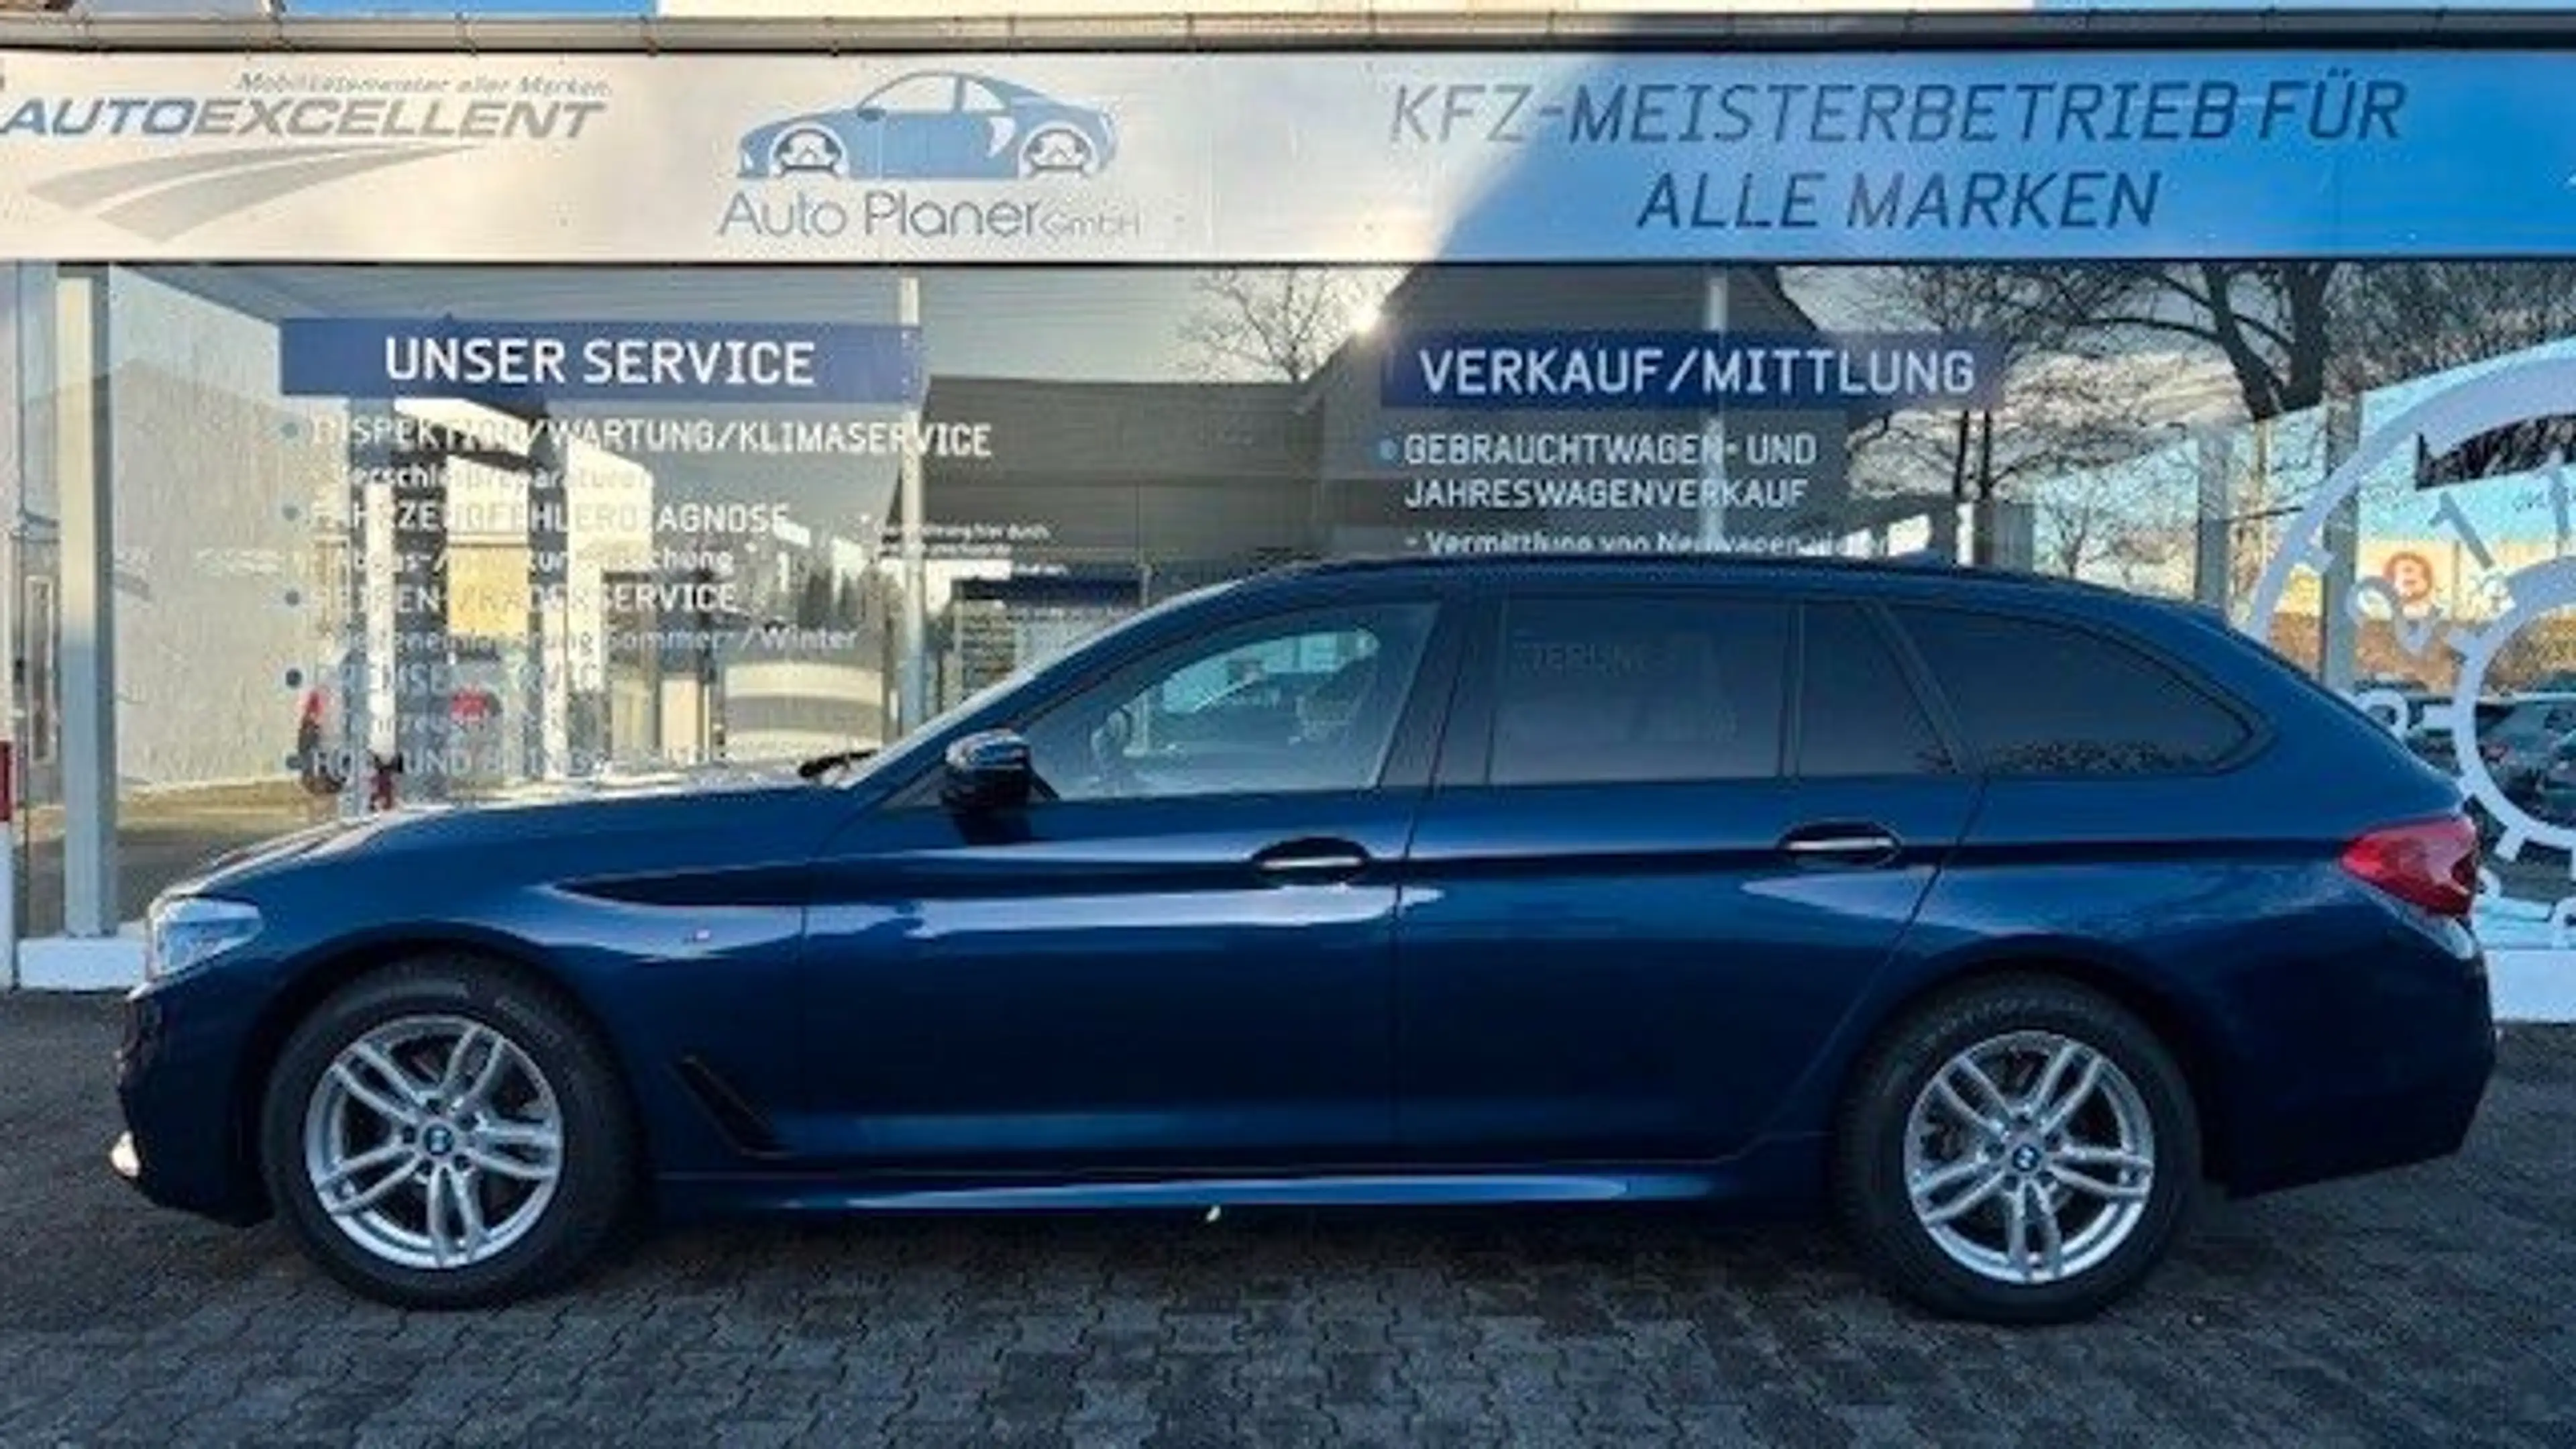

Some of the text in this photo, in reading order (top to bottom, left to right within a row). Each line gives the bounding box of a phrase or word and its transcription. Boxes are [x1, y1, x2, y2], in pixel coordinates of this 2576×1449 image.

[0, 97, 606, 138] AUTOEXCELLENT
[1390, 67, 2407, 144] KFZ-MEISTERBETRIEB FÜR
[718, 191, 848, 237] Auto
[865, 191, 1040, 239] Planer
[1637, 170, 2161, 229] ALLE MARKEN
[384, 337, 817, 386] UNSER SERVICE
[1419, 347, 1975, 394] VERKAUF/MITTLUNG
[1405, 433, 1817, 466] GEBRAUCHTWAGEN- UND
[1405, 478, 1809, 510] JAHRESWAGENVERKAUF
